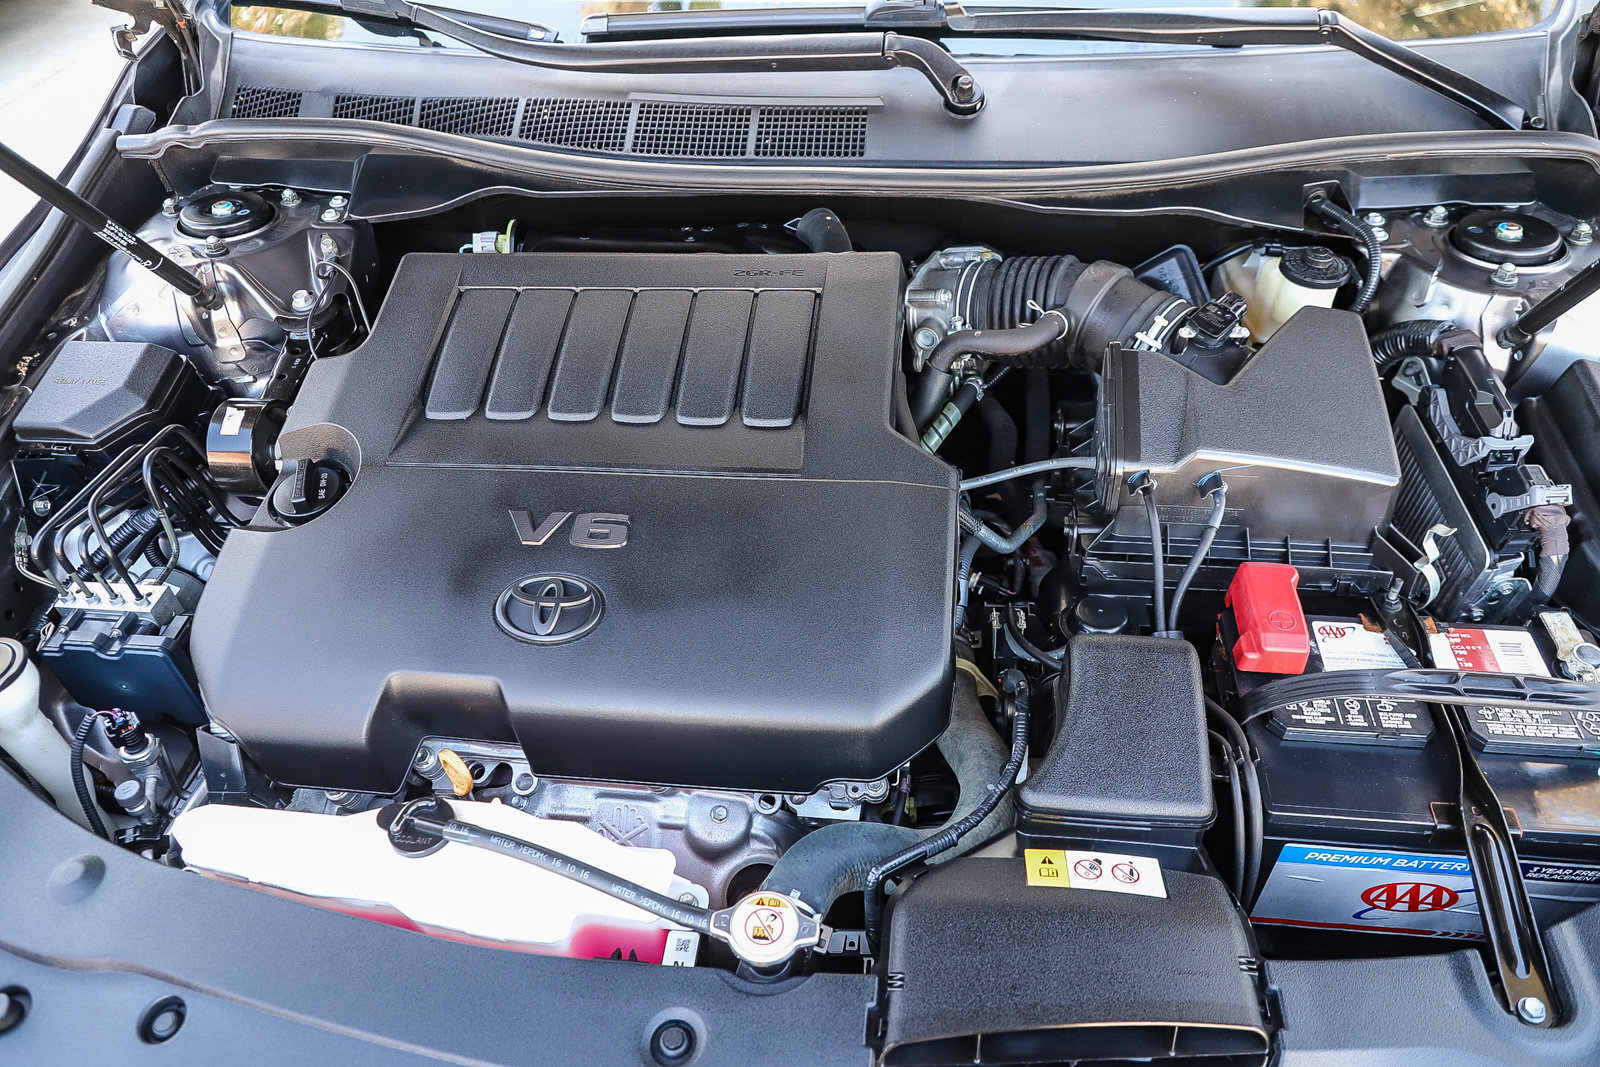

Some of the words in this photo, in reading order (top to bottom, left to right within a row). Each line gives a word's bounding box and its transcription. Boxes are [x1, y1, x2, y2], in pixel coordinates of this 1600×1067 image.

[317, 489, 326, 499] SAE
[508, 509, 631, 549] V6
[1318, 625, 1346, 639] AAA
[393, 834, 434, 846] COOLANT
[489, 834, 516, 850] WATER
[551, 857, 562, 868] 16
[565, 863, 576, 873] 10
[579, 869, 591, 879] 16
[1303, 851, 1392, 867] PREMIUM
[1525, 872, 1597, 882] REPLACEMENT
[1540, 867, 1573, 876] YEAR
[610, 882, 637, 900] WATER
[671, 909, 681, 919] 16
[684, 915, 694, 924] 10
[698, 918, 708, 928] 16
[1360, 882, 1460, 913] AAA
